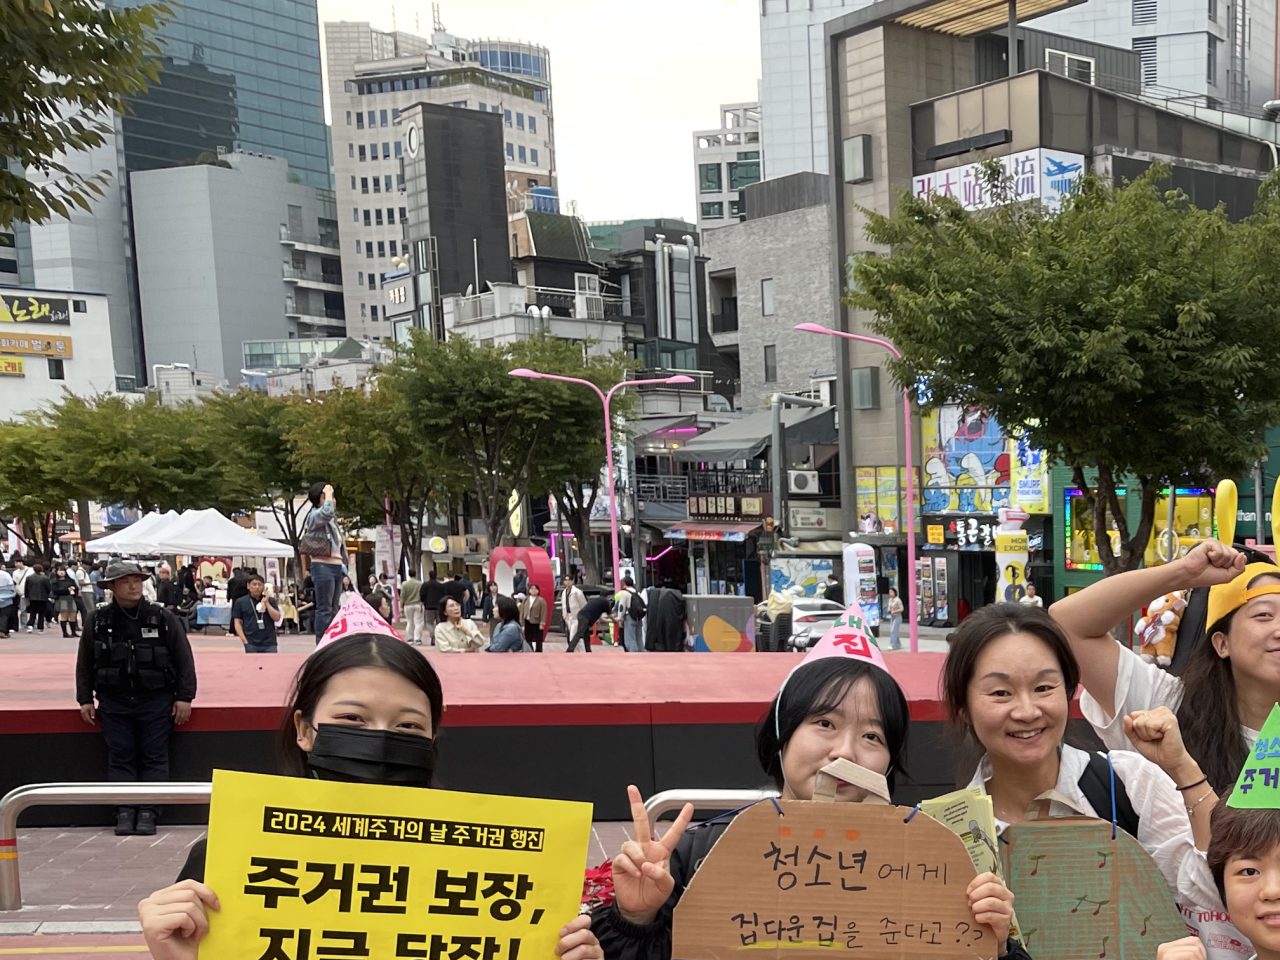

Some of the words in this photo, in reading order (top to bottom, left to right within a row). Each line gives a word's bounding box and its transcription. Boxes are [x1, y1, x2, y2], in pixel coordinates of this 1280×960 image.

[270, 811, 326, 831] 2024
[331, 815, 424, 841] 세계주거의
[429, 822, 447, 844] 날
[451, 825, 506, 848] 주거권
[509, 827, 544, 851] 행진
[243, 856, 410, 914] 주거권
[427, 869, 546, 925] 보장,
[730, 912, 806, 946] 집다운
[879, 917, 943, 946] 준다고
